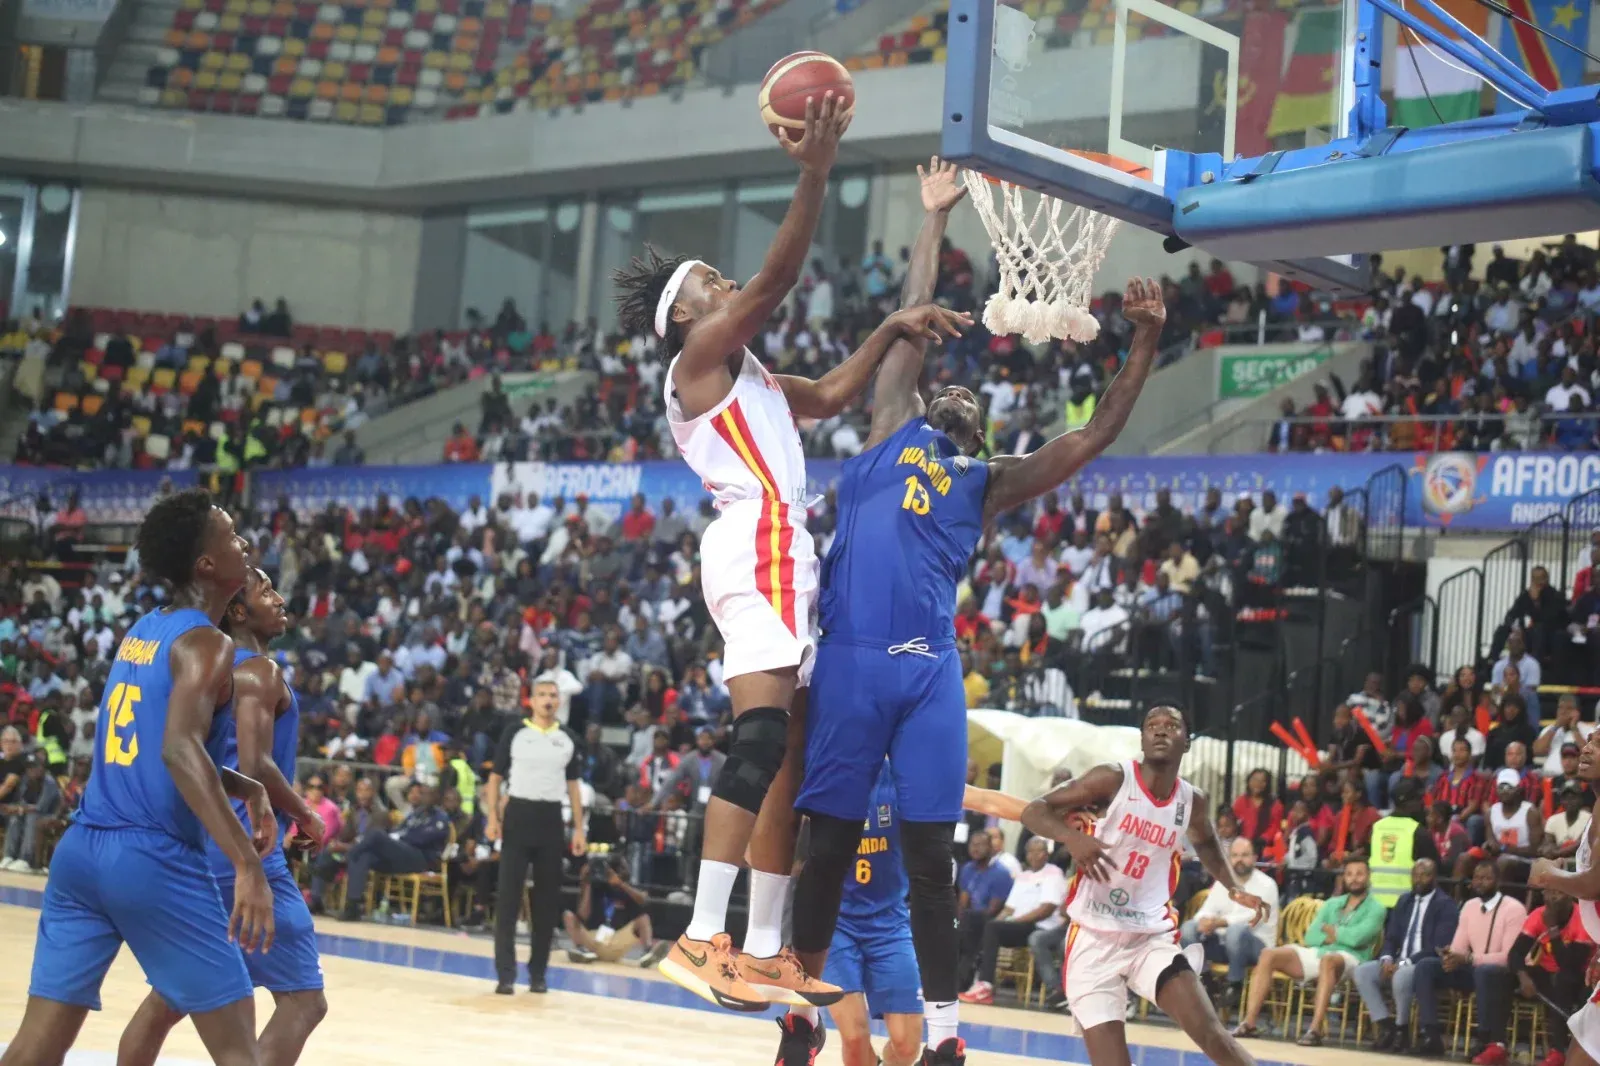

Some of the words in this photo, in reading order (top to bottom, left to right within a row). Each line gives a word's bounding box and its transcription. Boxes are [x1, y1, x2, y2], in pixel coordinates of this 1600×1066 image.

[543, 464, 642, 500] AFROCAN
[1491, 455, 1600, 496] AFROC
[105, 682, 141, 766] 15
[1118, 813, 1177, 848] ANGOLA
[855, 859, 872, 884] 6
[1122, 850, 1150, 880] 13
